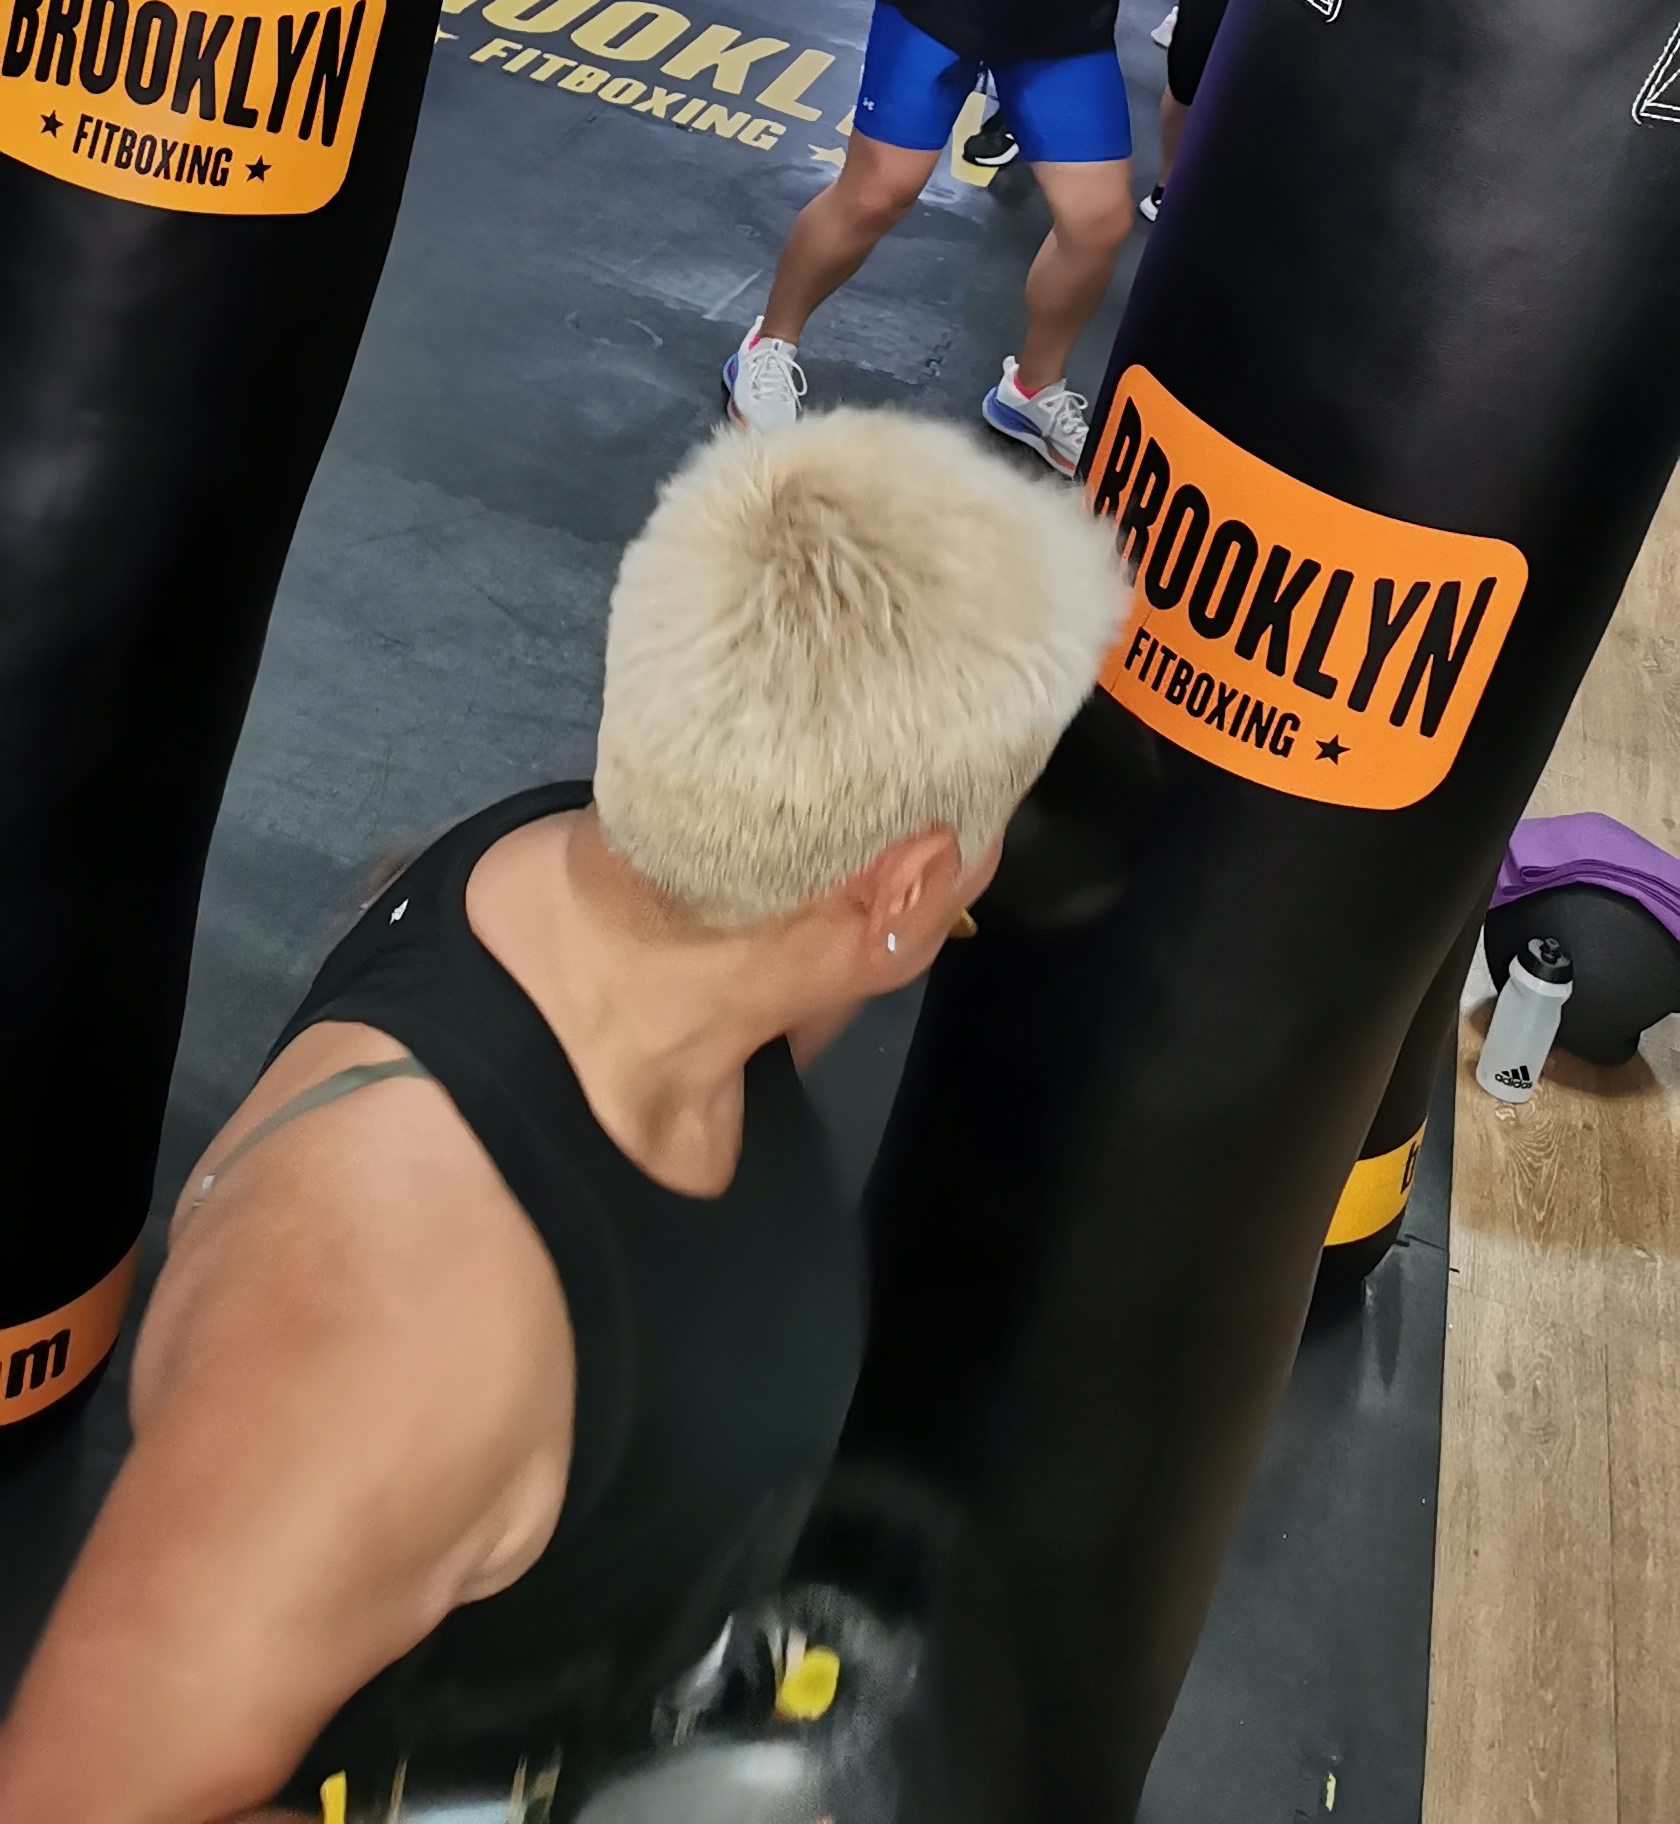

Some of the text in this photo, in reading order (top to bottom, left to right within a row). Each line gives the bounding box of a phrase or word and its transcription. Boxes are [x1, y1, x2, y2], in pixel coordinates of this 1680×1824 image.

[72, 114, 233, 187] FITBOXING
[469, 37, 787, 151] FITBOXING
[1094, 396, 1497, 738] BROOKLYN
[1124, 626, 1301, 758] FITBOXING
[1494, 1073, 1533, 1089] adidas
